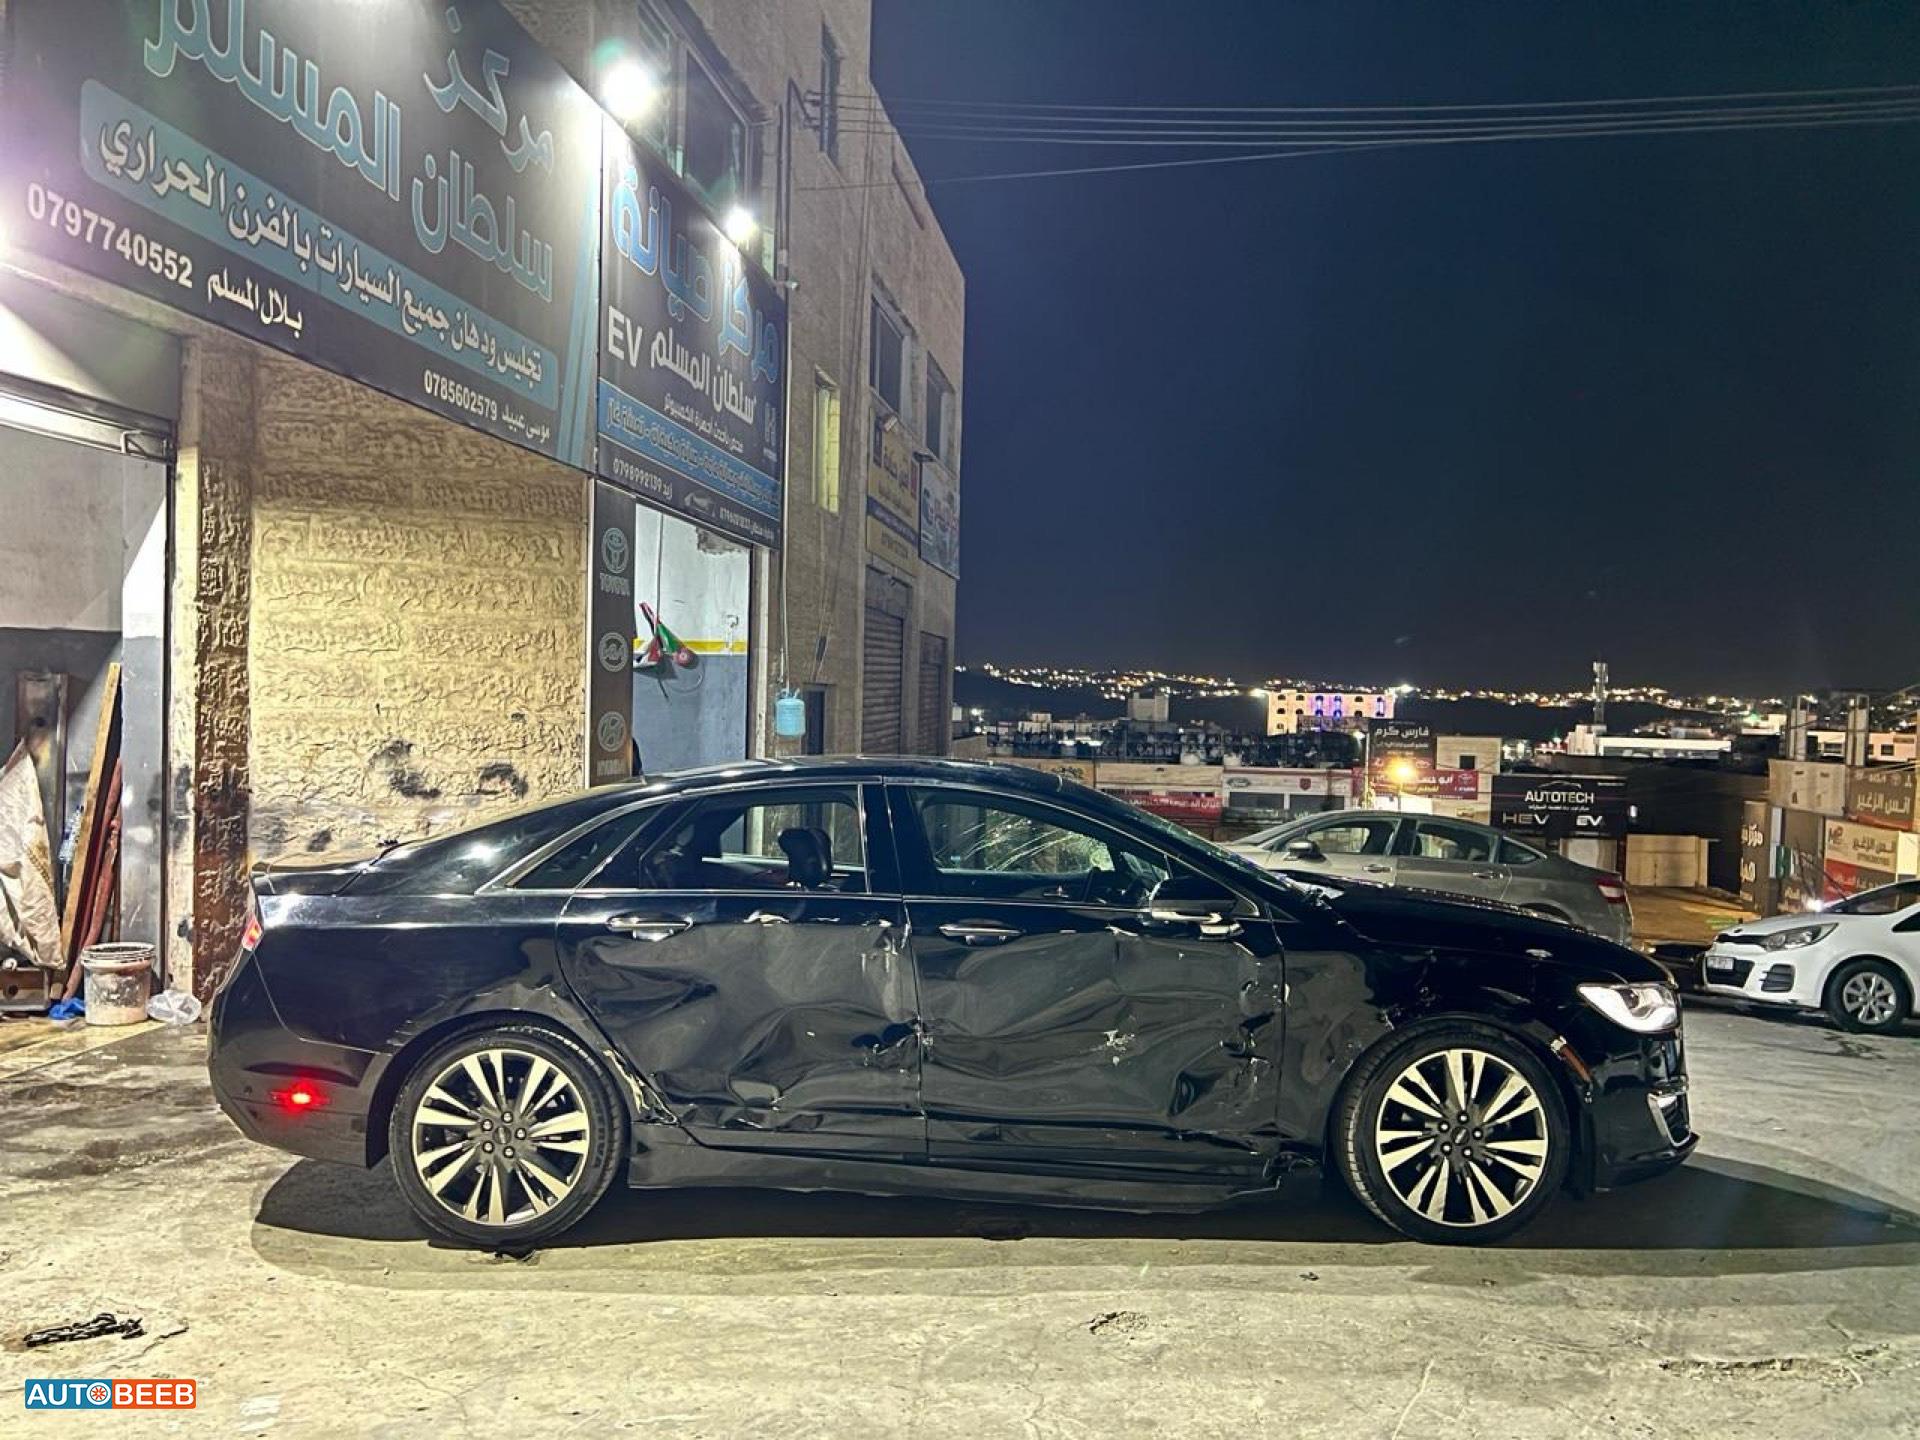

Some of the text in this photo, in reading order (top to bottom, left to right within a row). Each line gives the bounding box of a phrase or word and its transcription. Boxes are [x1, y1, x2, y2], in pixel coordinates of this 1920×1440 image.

[424, 7, 554, 174] مركز
[100, 120, 226, 214] الحراري
[27, 182, 303, 338] بلال المسلم 0797740552
[227, 184, 312, 272] بالفرن
[314, 222, 400, 307] السيارات
[410, 150, 553, 302] سلطان
[402, 289, 450, 341] جميع
[612, 166, 779, 383] مركز صيانة
[423, 368, 497, 421] 0785602579
[497, 344, 542, 389] تجليس
[608, 305, 756, 425] سلطان المسلم EV
[1502, 813, 1550, 825] HEV
[1524, 790, 1594, 804] AUTOTECH
[1576, 815, 1603, 826] EV
